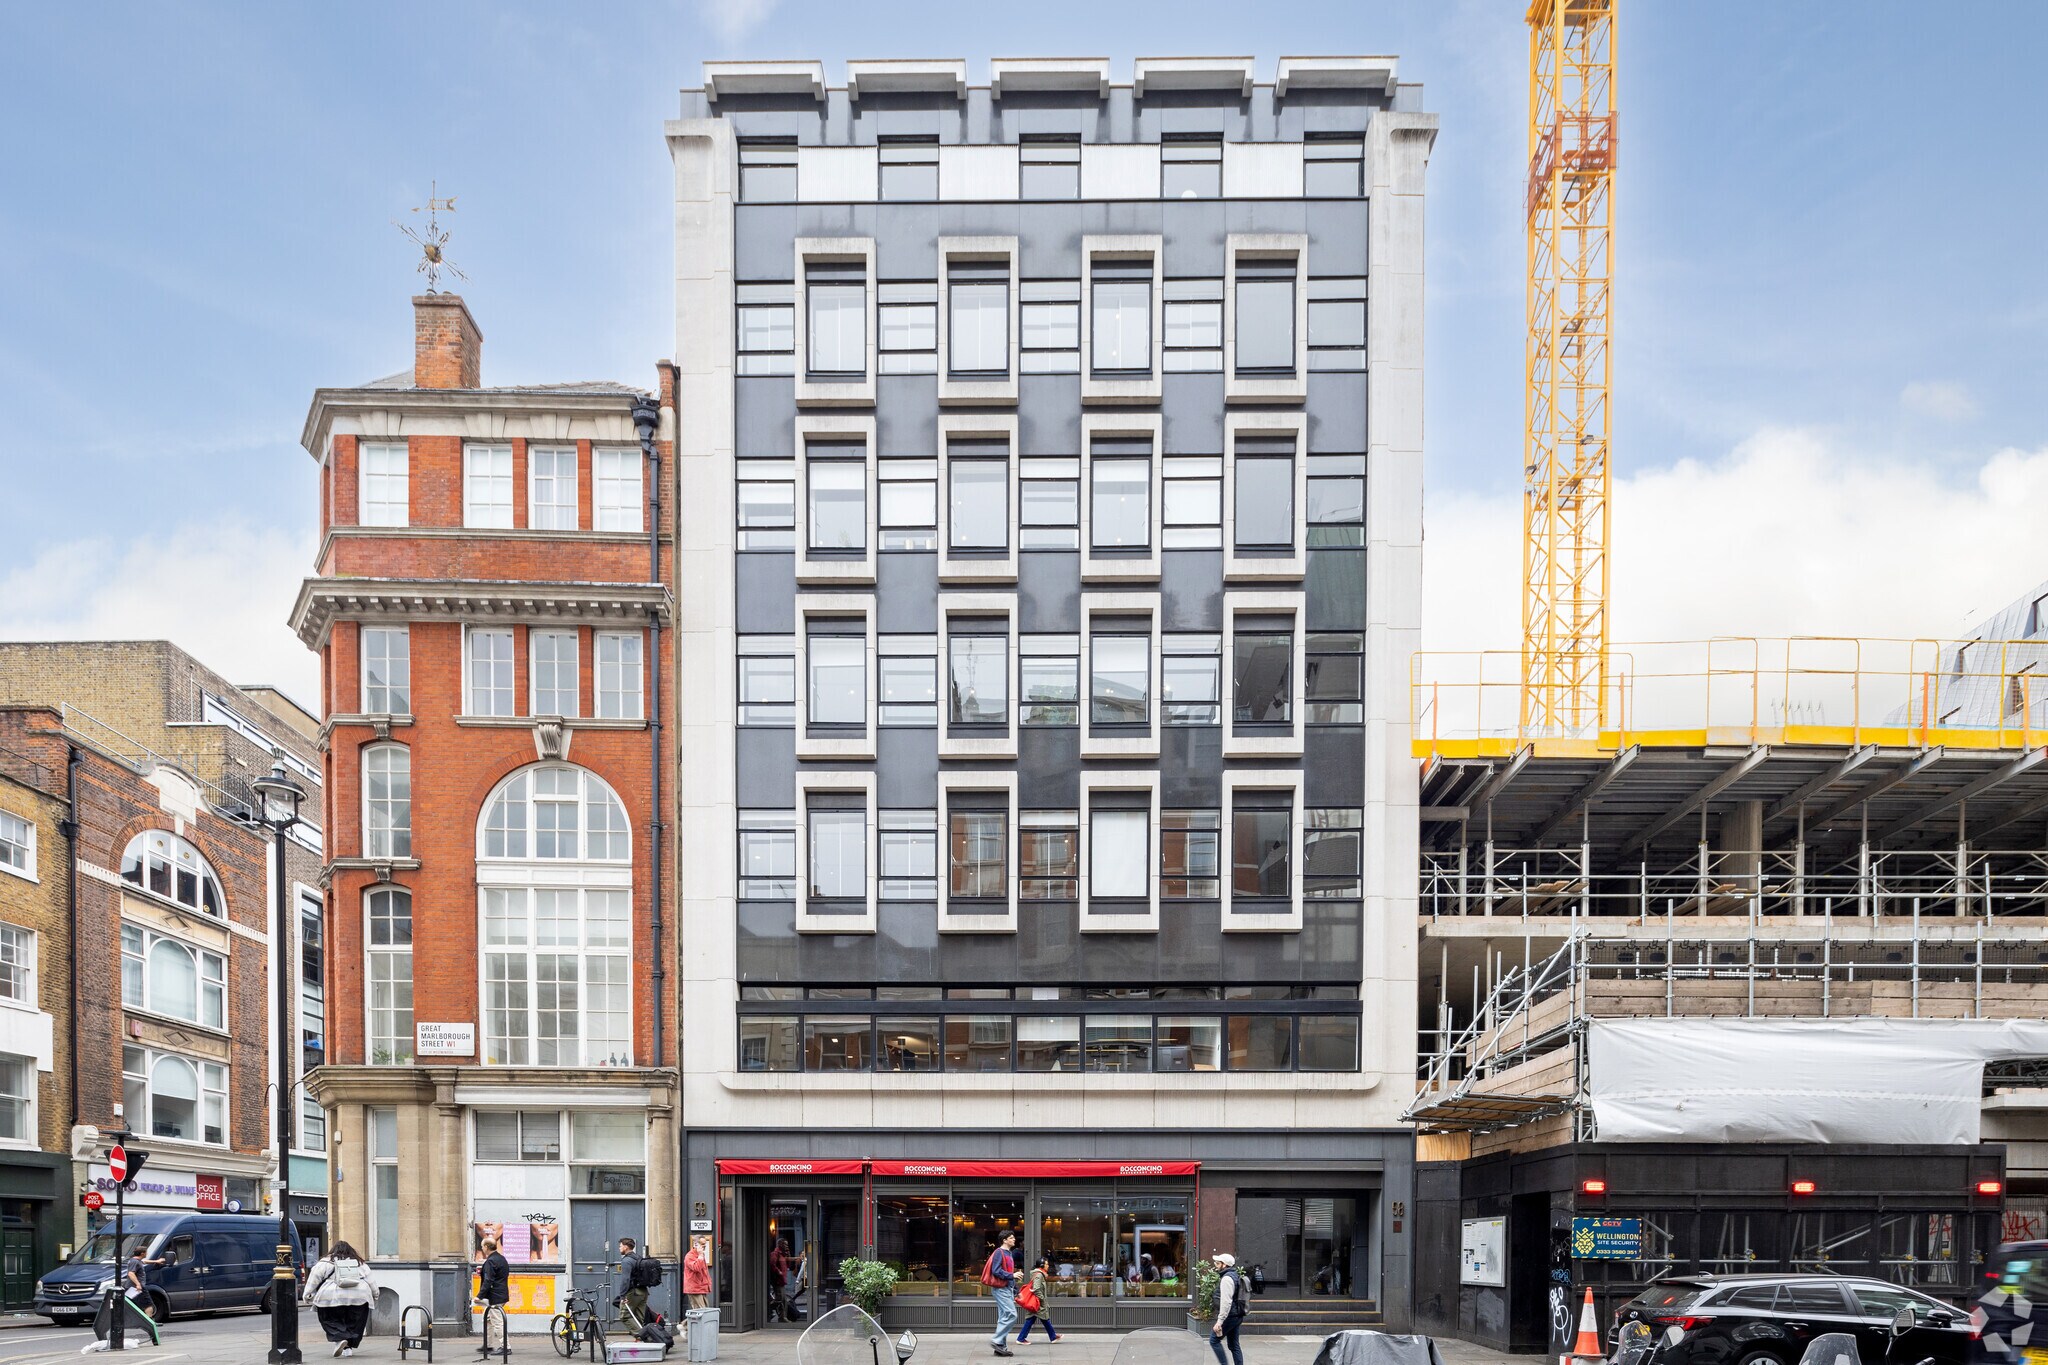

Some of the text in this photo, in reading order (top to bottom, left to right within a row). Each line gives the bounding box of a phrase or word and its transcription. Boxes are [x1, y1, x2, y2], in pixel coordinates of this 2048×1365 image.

[97, 1178, 138, 1192] SOO
[140, 1183, 164, 1193] FOOD
[174, 1185, 196, 1196] WINE
[198, 1184, 218, 1192] POST
[196, 1192, 220, 1201] OFFICE
[298, 1205, 328, 1215] HEADM
[694, 1201, 706, 1216] 59
